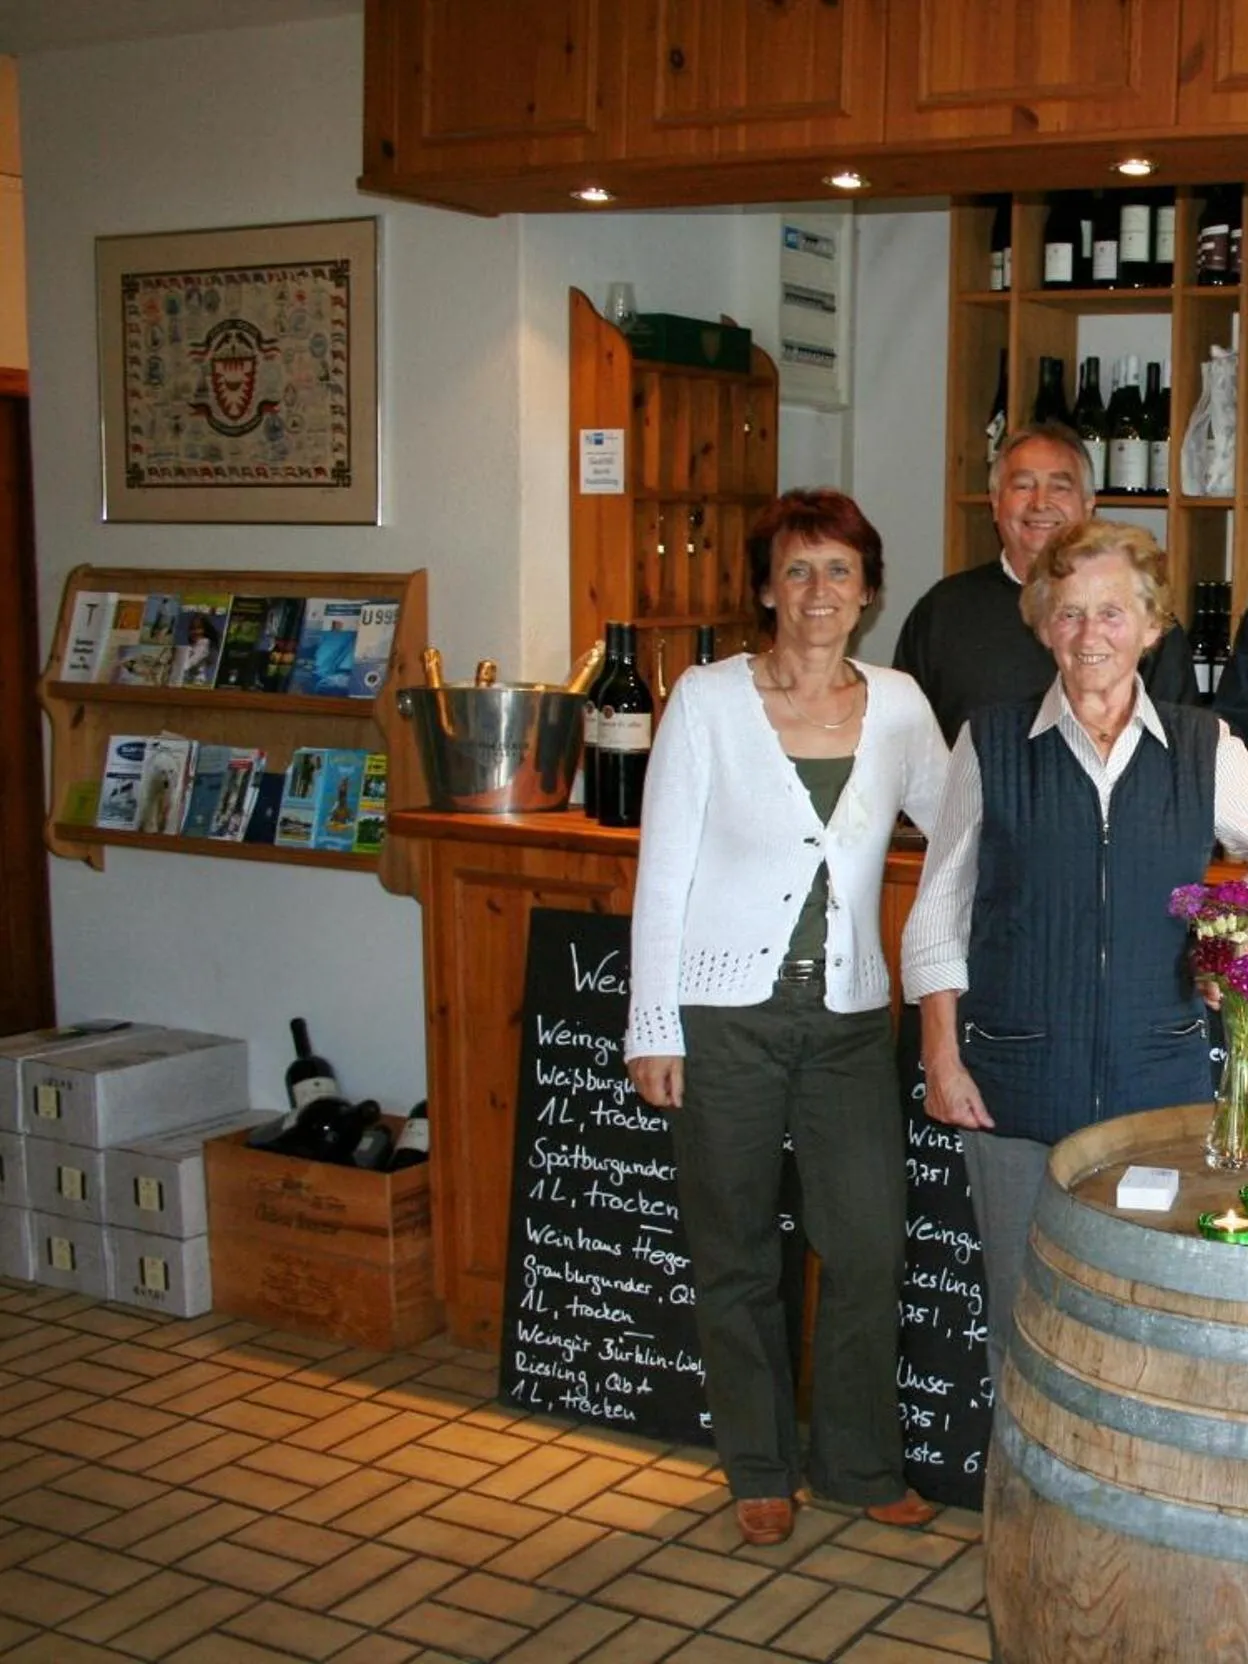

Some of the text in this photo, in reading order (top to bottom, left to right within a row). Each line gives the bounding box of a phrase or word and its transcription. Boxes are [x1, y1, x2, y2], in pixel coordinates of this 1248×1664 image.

[570, 942, 628, 994] Wei
[537, 1014, 627, 1066] Weingu
[536, 1058, 637, 1106] Weißburgu
[908, 1118, 965, 1153] Winz
[528, 1137, 678, 1187] Spätburgunder
[583, 1179, 680, 1221] trocken
[526, 1217, 692, 1276] Weinhaus Heger
[565, 1295, 636, 1325] trocken
[904, 1262, 983, 1316] iesling
[559, 1390, 636, 1421] trocken
[904, 1437, 945, 1465] iste
